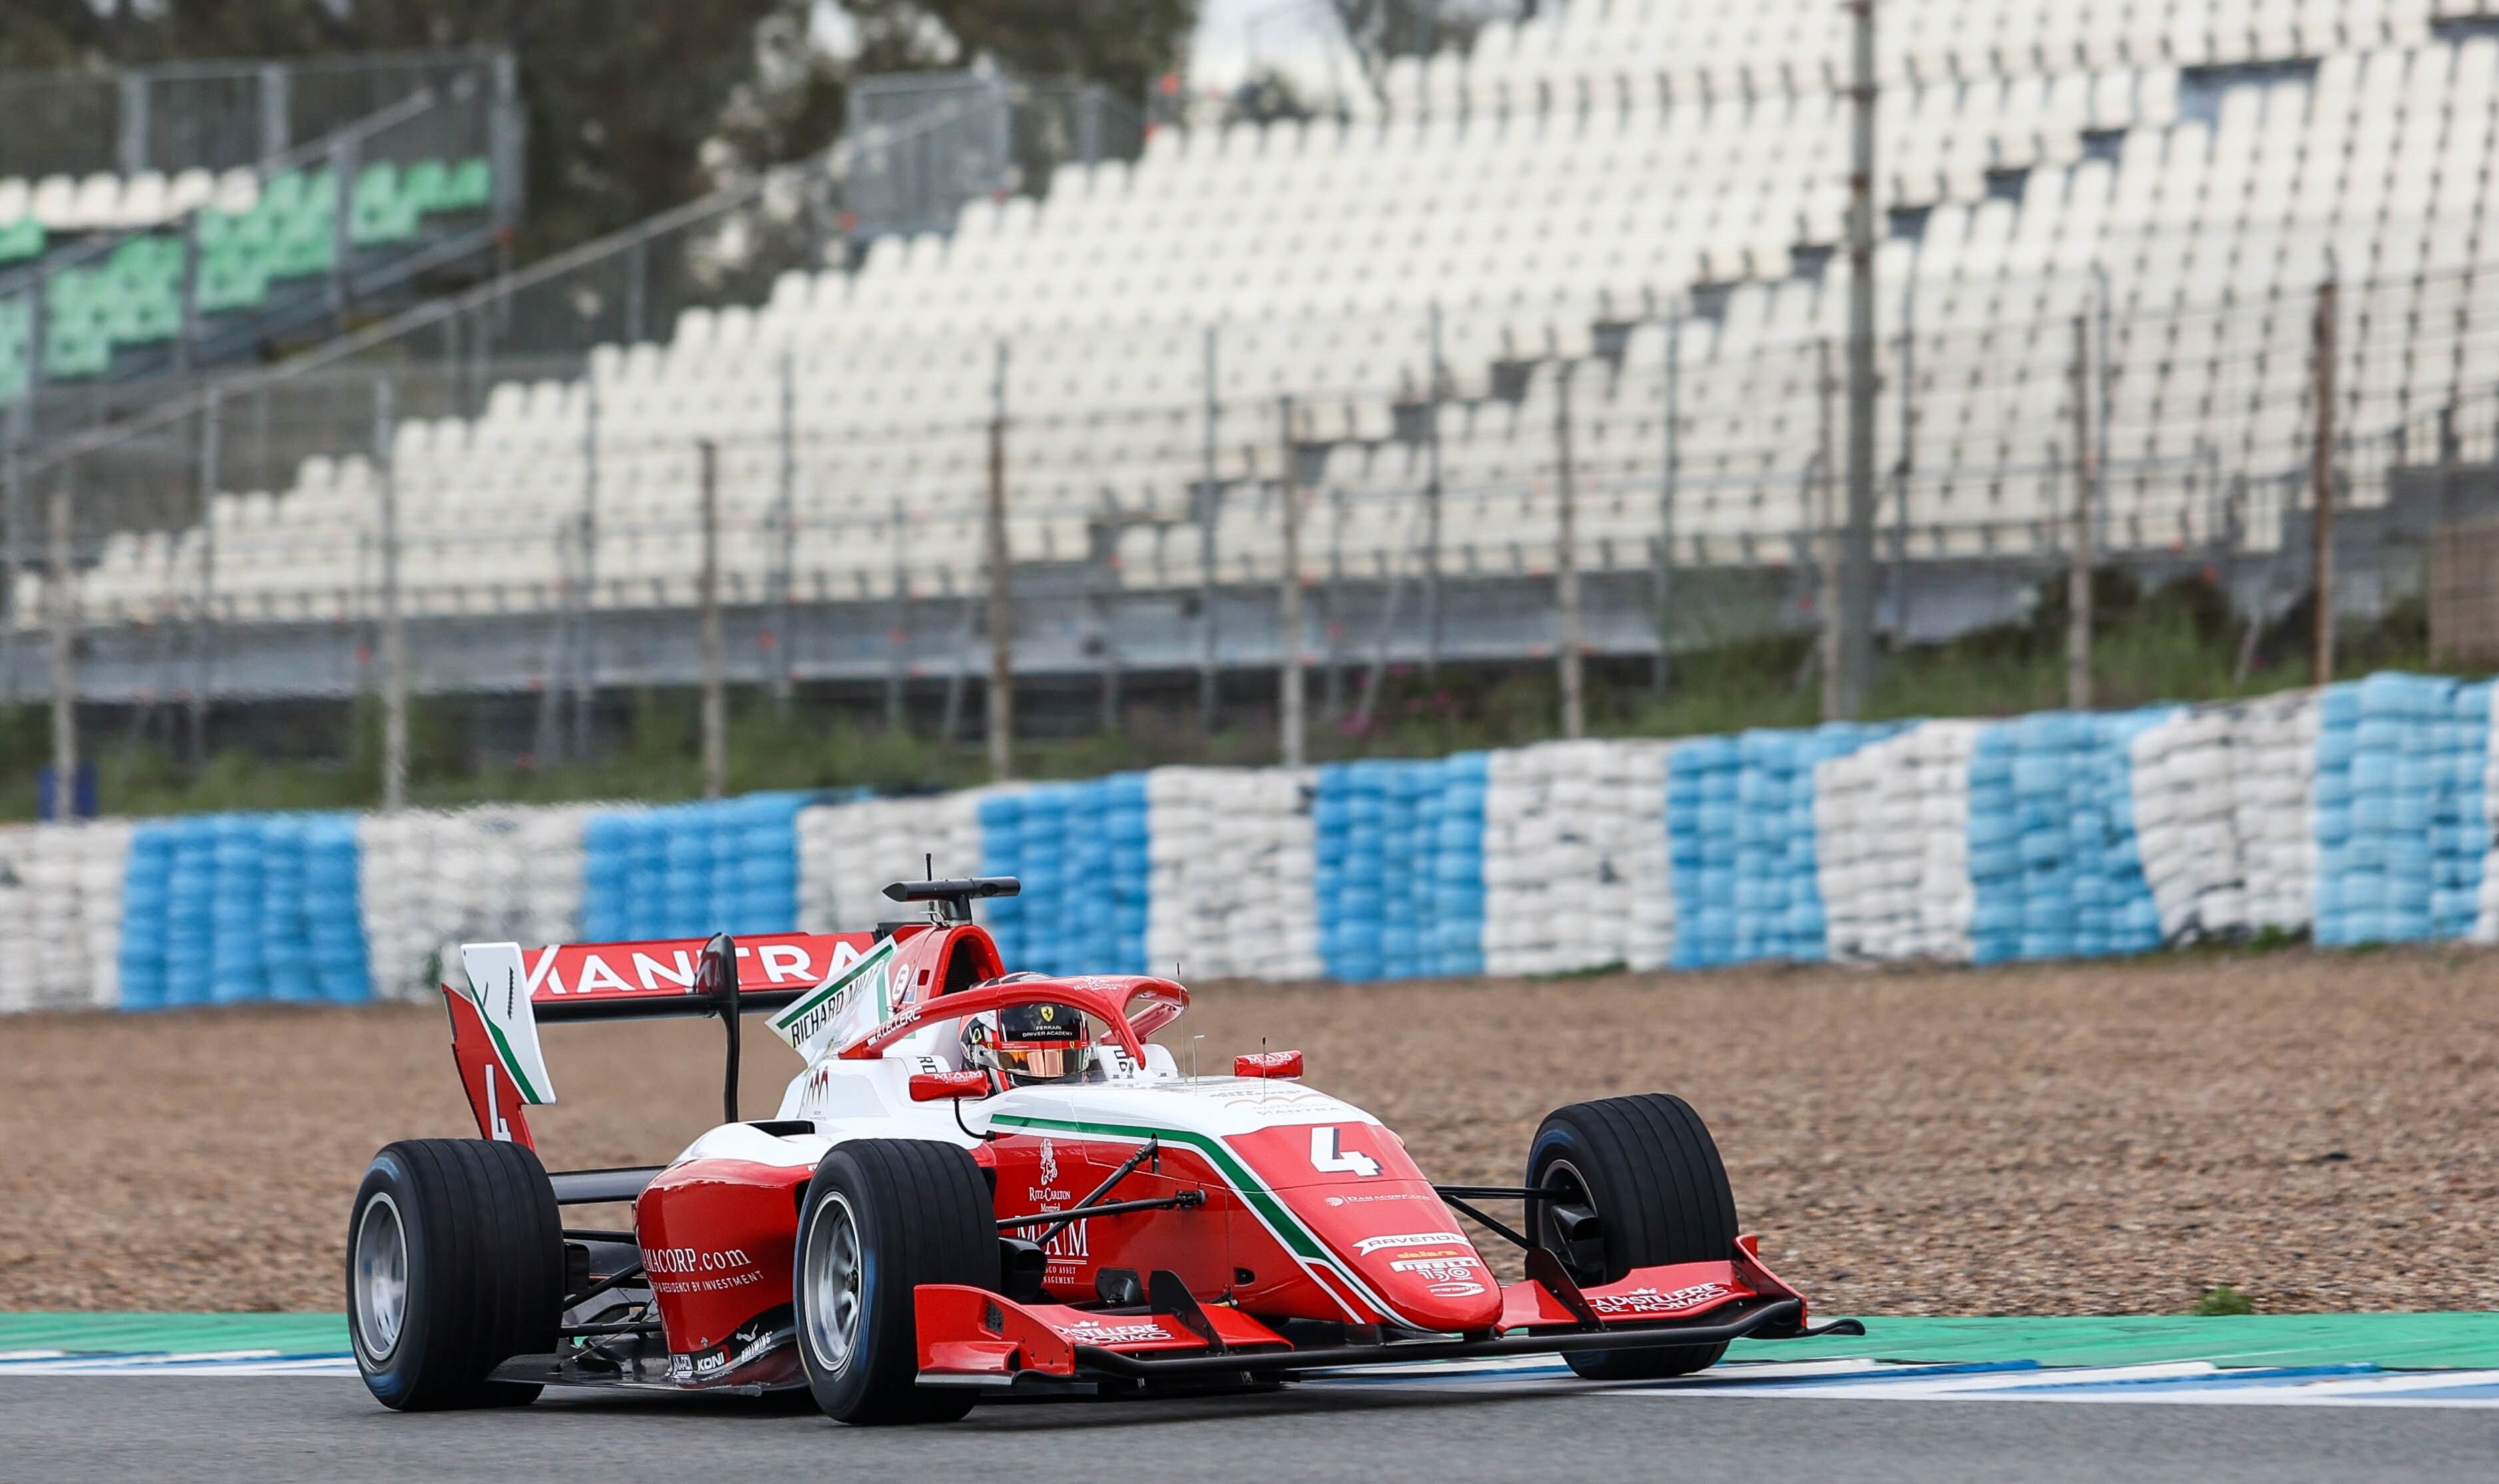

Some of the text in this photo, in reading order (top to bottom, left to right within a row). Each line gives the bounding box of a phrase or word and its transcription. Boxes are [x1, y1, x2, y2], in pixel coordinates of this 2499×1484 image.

[791, 991, 845, 1049] RICHARD
[1310, 1127, 1381, 1176] 4
[1368, 1235, 1463, 1246] RAVENOL
[1390, 1256, 1481, 1272] PIRELLI
[1398, 1250, 1458, 1259] dallara
[691, 1281, 701, 1292] BY
[703, 1270, 764, 1291] INVESTMENT
[1634, 1289, 1728, 1312] MONACO
[1075, 1332, 1175, 1345] MONACO
[697, 1352, 725, 1372] KONI
